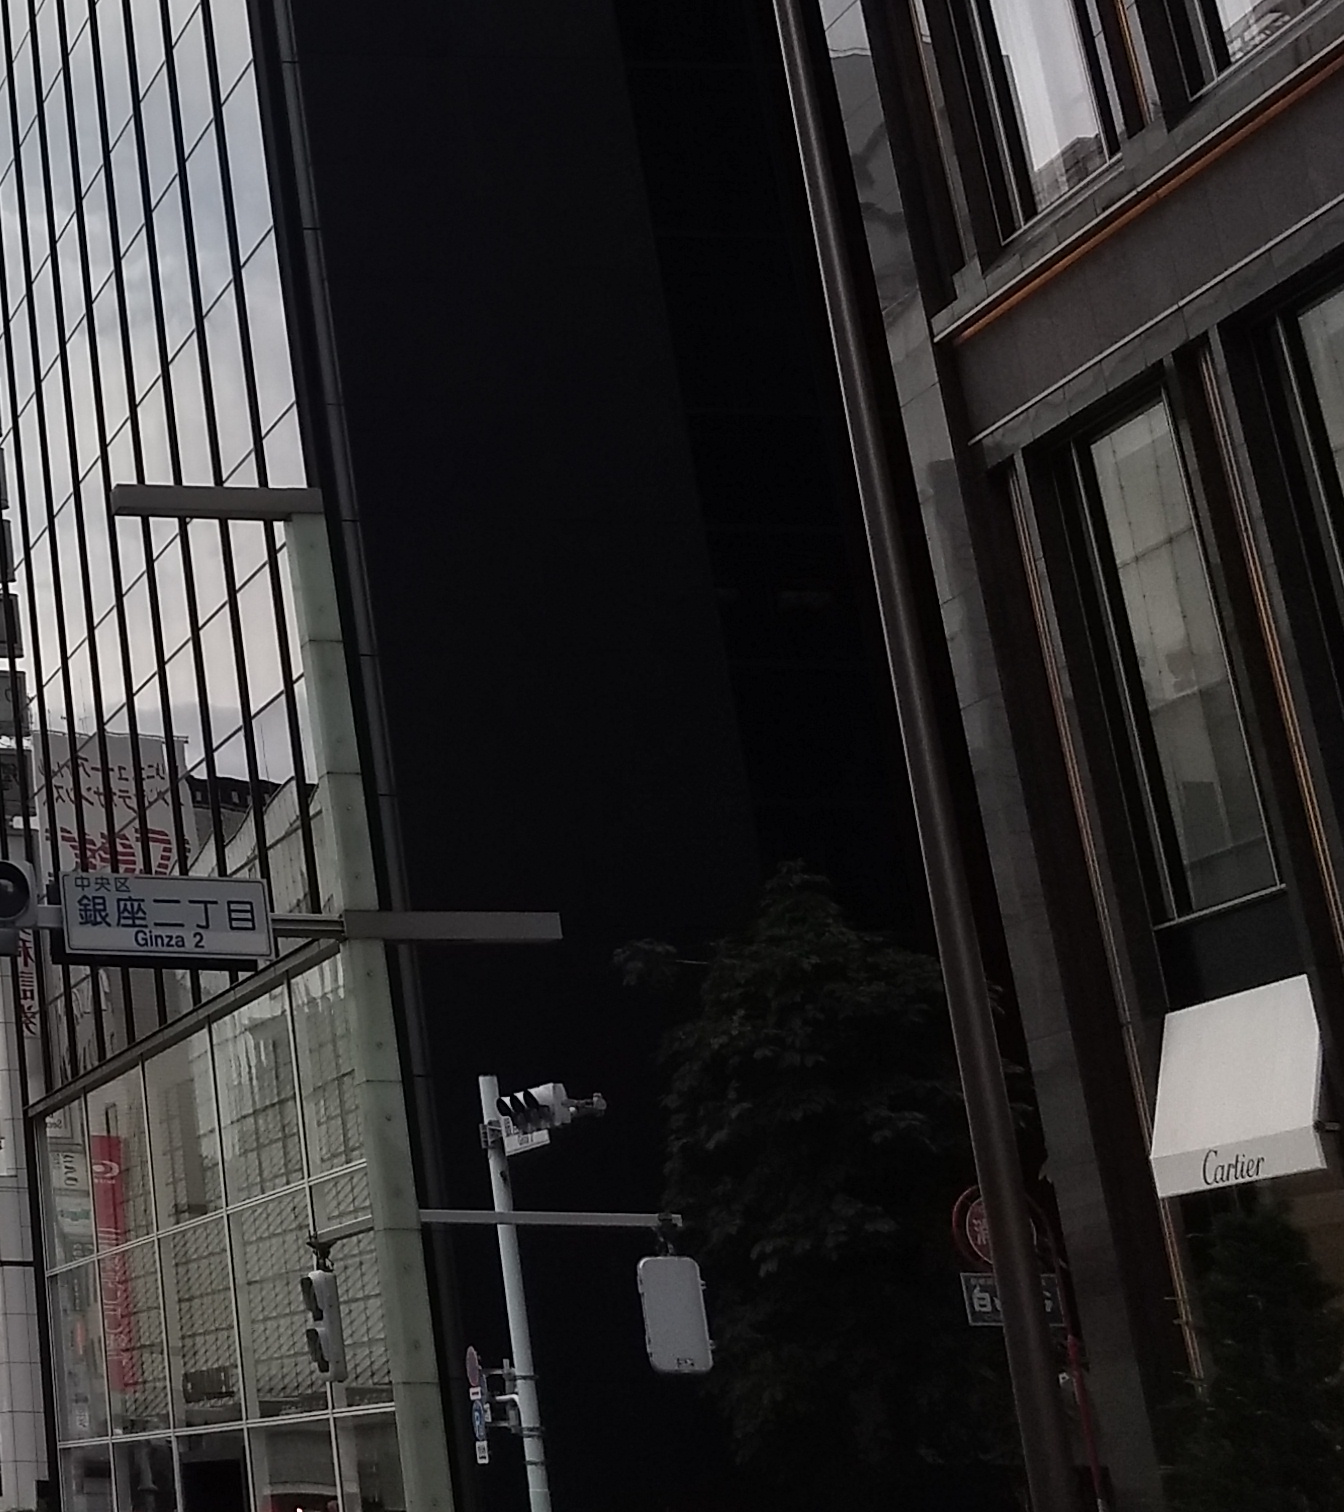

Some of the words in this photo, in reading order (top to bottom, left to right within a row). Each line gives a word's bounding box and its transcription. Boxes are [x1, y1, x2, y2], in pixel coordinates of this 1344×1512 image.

[74, 875, 131, 893] 中央区
[77, 894, 256, 931] 銀座二丁目
[134, 930, 186, 949] Ginza
[193, 932, 206, 949] 2
[1201, 1148, 1266, 1187] Cartier
